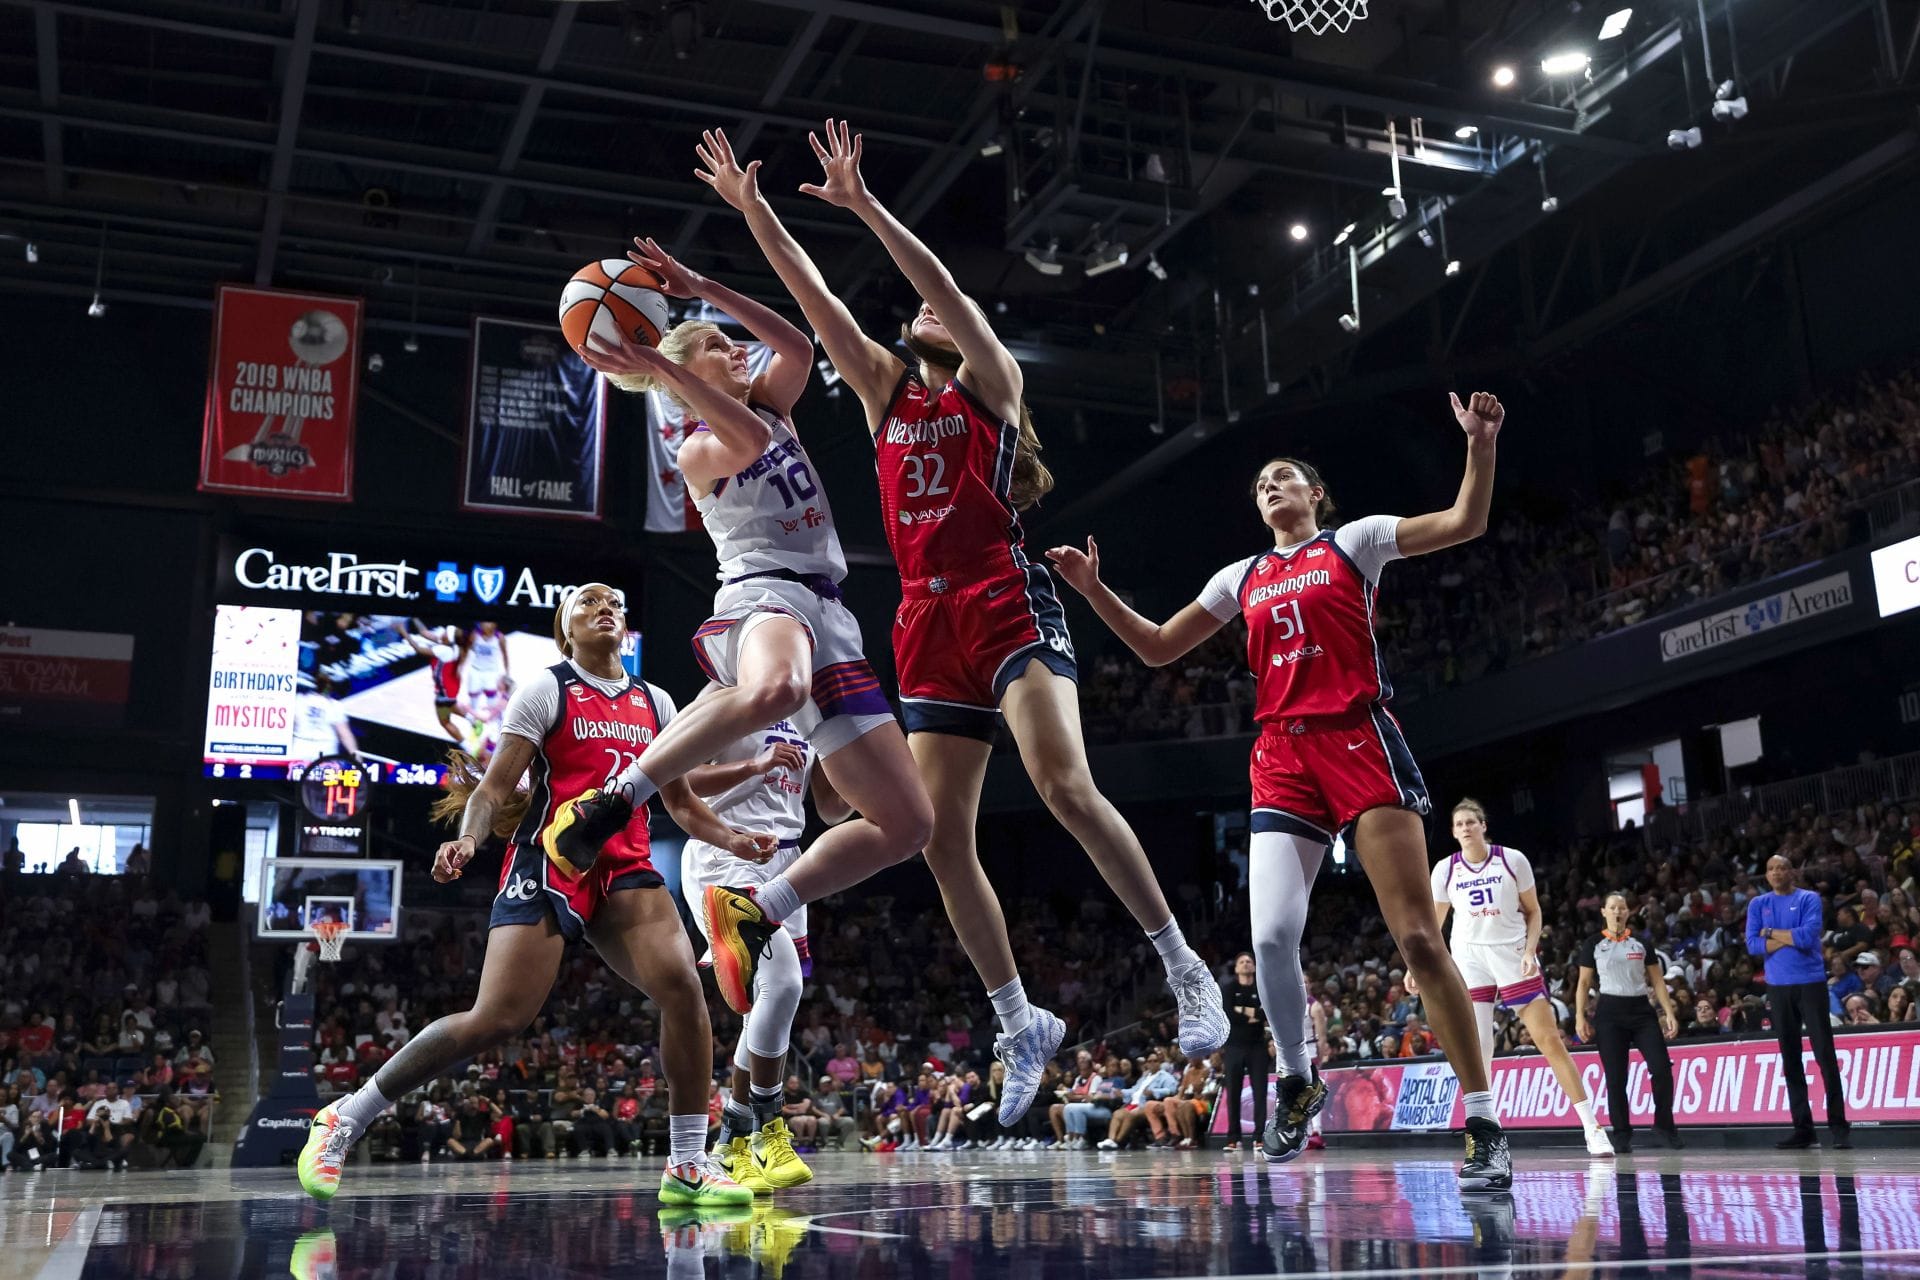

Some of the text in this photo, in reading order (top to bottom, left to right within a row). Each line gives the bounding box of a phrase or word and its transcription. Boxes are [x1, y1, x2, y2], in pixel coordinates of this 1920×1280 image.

[236, 361, 333, 393] 2019 WNBA
[230, 388, 335, 420] CHAMPIONS
[491, 476, 522, 497] HALL
[538, 480, 573, 501] FAME
[766, 461, 818, 510] 10
[903, 453, 950, 498] 32
[235, 548, 419, 599] CareFirst
[1249, 568, 1331, 608] Washington
[1270, 599, 1305, 640] 51
[1662, 584, 1850, 657] CareFirst Arena
[1282, 644, 1324, 662] VANDA
[29, 676, 89, 696] TEAM
[213, 671, 293, 692] BIRTHDAYS
[215, 704, 287, 729] MYSTICS
[573, 716, 654, 747] Washington
[213, 763, 225, 778] 5
[239, 764, 252, 779] 2
[325, 785, 357, 816] 14
[319, 826, 362, 837] TISSOT
[1456, 875, 1503, 891] MERCURY
[1469, 888, 1494, 906] 31
[1399, 1078, 1437, 1105] CAPITAL
[1672, 1057, 1708, 1114] IS
[1708, 1054, 1748, 1113] IN
